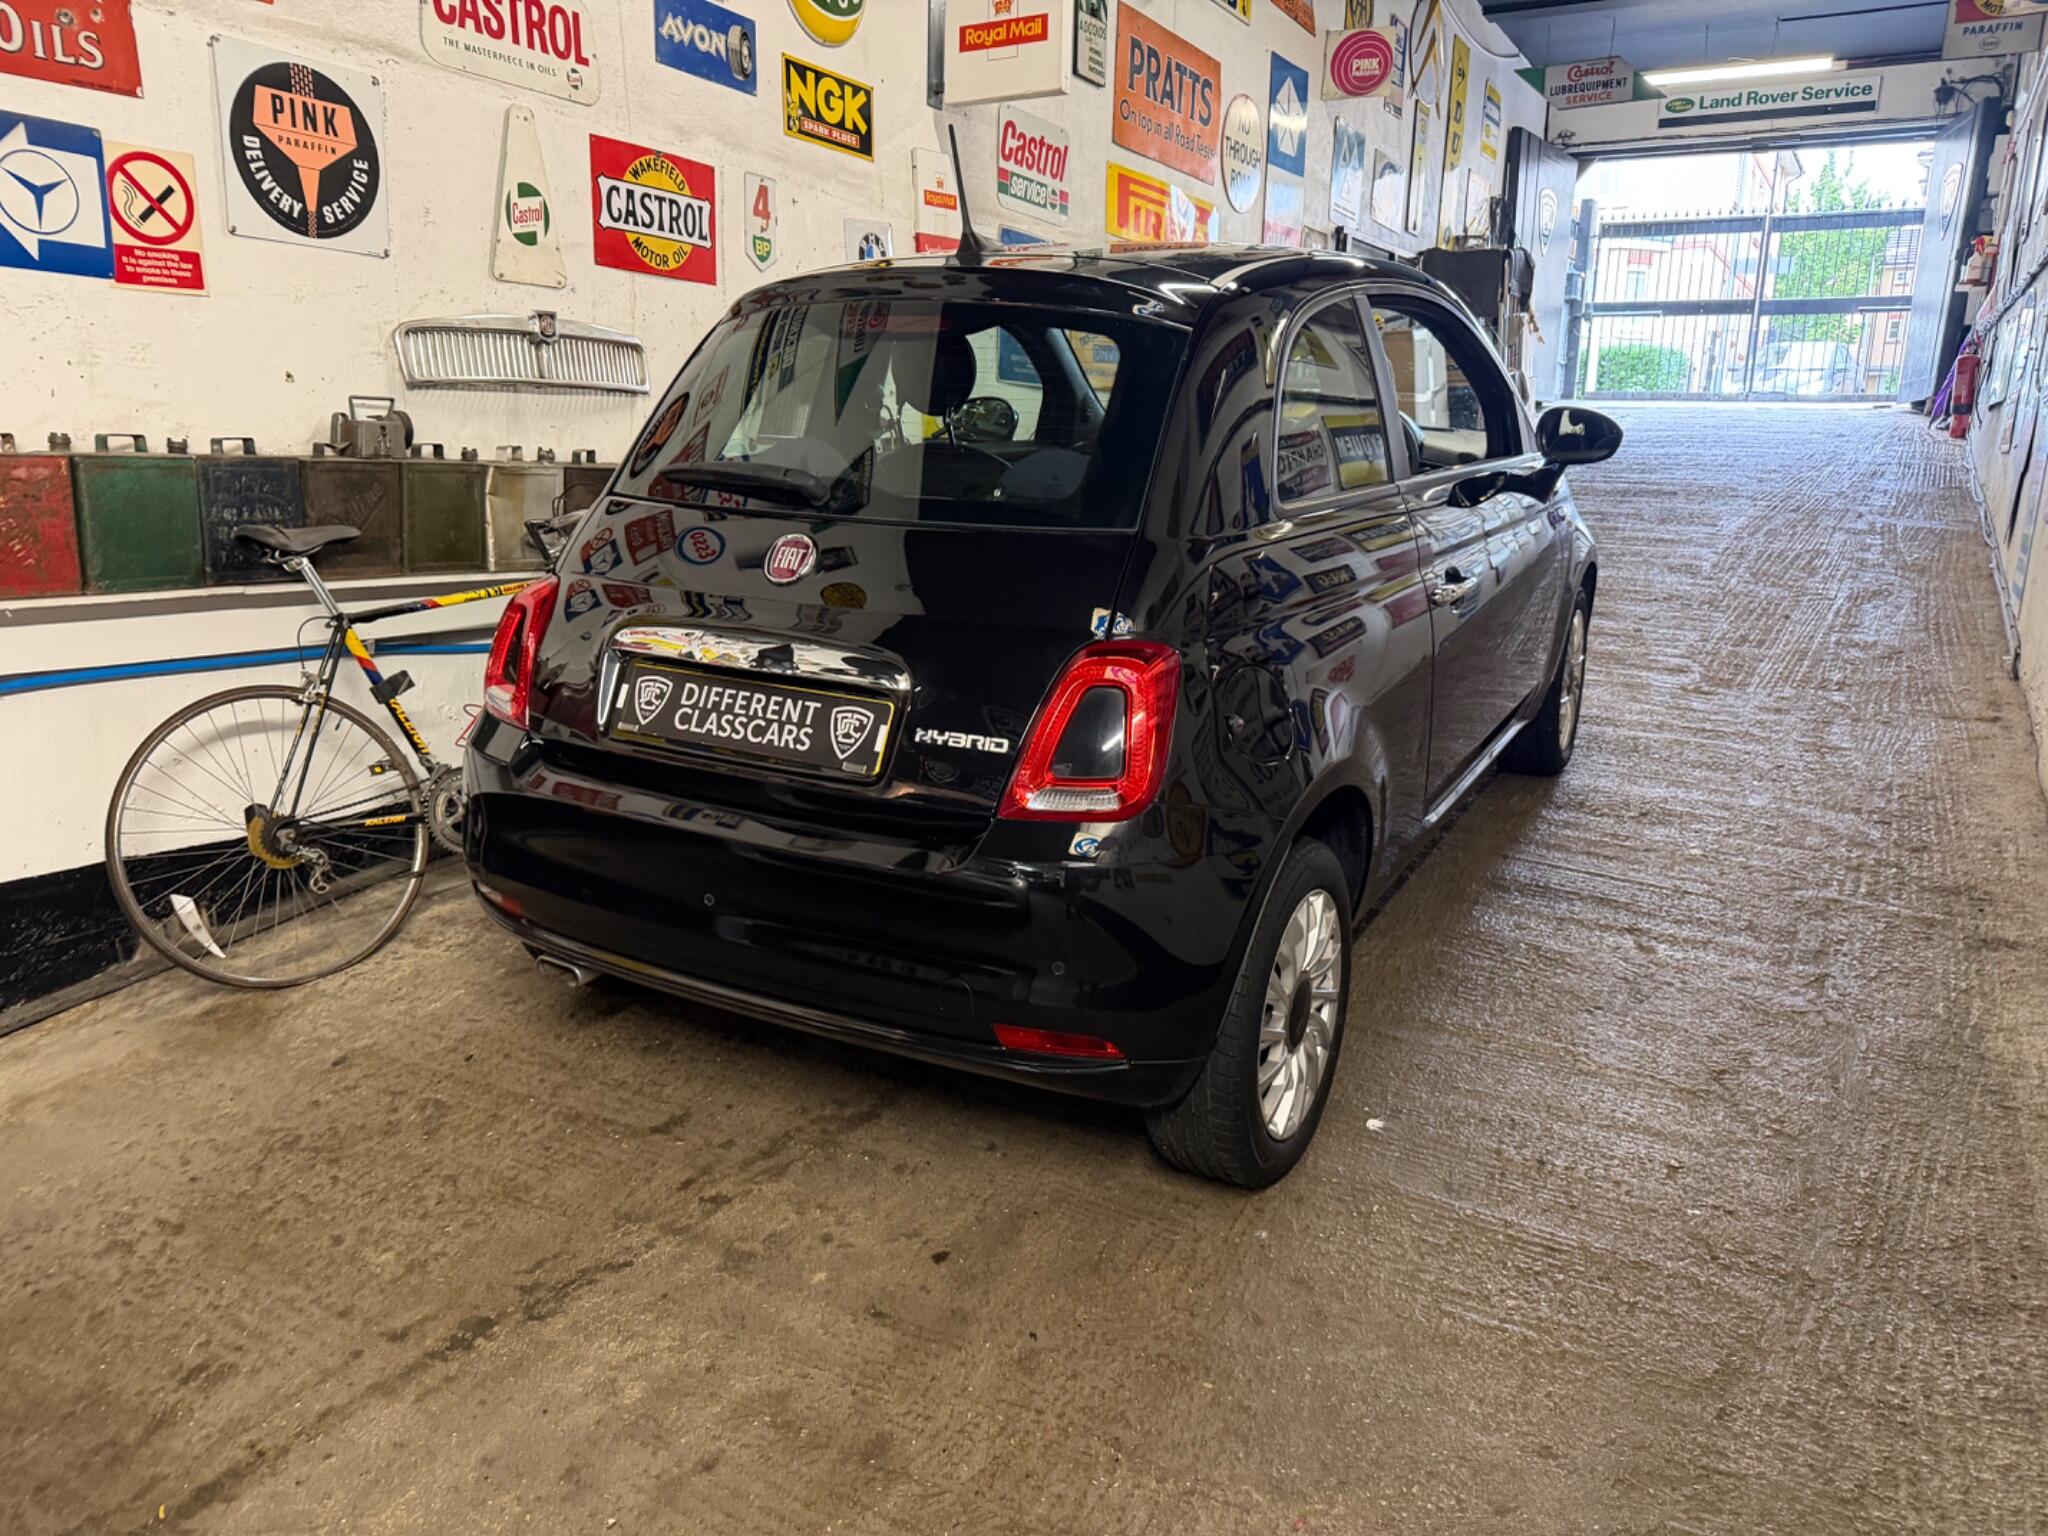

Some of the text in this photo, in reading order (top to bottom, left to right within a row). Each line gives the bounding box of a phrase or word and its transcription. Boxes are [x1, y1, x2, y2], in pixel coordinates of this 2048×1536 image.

[0, 1, 103, 69] OILS
[658, 12, 727, 63] AVON
[965, 17, 1042, 46] Royal Mail
[1962, 21, 2024, 36] PARAFFIN
[443, 36, 557, 77] THE MASTERPIECE IN OILS
[1353, 57, 1381, 71] PINK
[1127, 34, 1214, 128] PRATTS
[1567, 60, 1616, 83] Castrol
[789, 63, 868, 135] NGK
[1549, 77, 1628, 97] LUBREQUIPMENT
[1565, 90, 1614, 105] SERVICE
[1698, 94, 1743, 110] Land
[1746, 89, 1799, 106] Rover
[1801, 82, 1874, 101] Service
[270, 93, 339, 138] PINK
[1119, 98, 1137, 123] On
[1138, 112, 1152, 135] top
[1154, 121, 1163, 136] in
[1163, 121, 1174, 141] all
[1175, 123, 1195, 152] Road
[277, 134, 337, 156] PARAFFIN
[802, 118, 857, 145] SPARK PLUGS
[1000, 119, 1069, 183] Castrol
[1225, 136, 1261, 169] THROUGH
[242, 134, 303, 220] DELIVERY
[628, 157, 686, 192] WAKEFIELD
[322, 158, 370, 224] SERVICE
[1010, 175, 1047, 205] service
[511, 200, 543, 225] Castrol
[605, 184, 709, 242] CASTROL
[146, 251, 180, 262] smoking
[631, 235, 689, 269] MOTOR OIL
[754, 239, 771, 256] BP
[135, 266, 161, 275] smoke
[137, 258, 166, 268] against
[166, 260, 179, 269] the
[142, 275, 178, 284] premises
[774, 547, 807, 571] FIAT
[680, 682, 822, 726] DIFFERENT
[673, 706, 815, 751] CLASSCARS
[914, 727, 1009, 754] HYBRID
